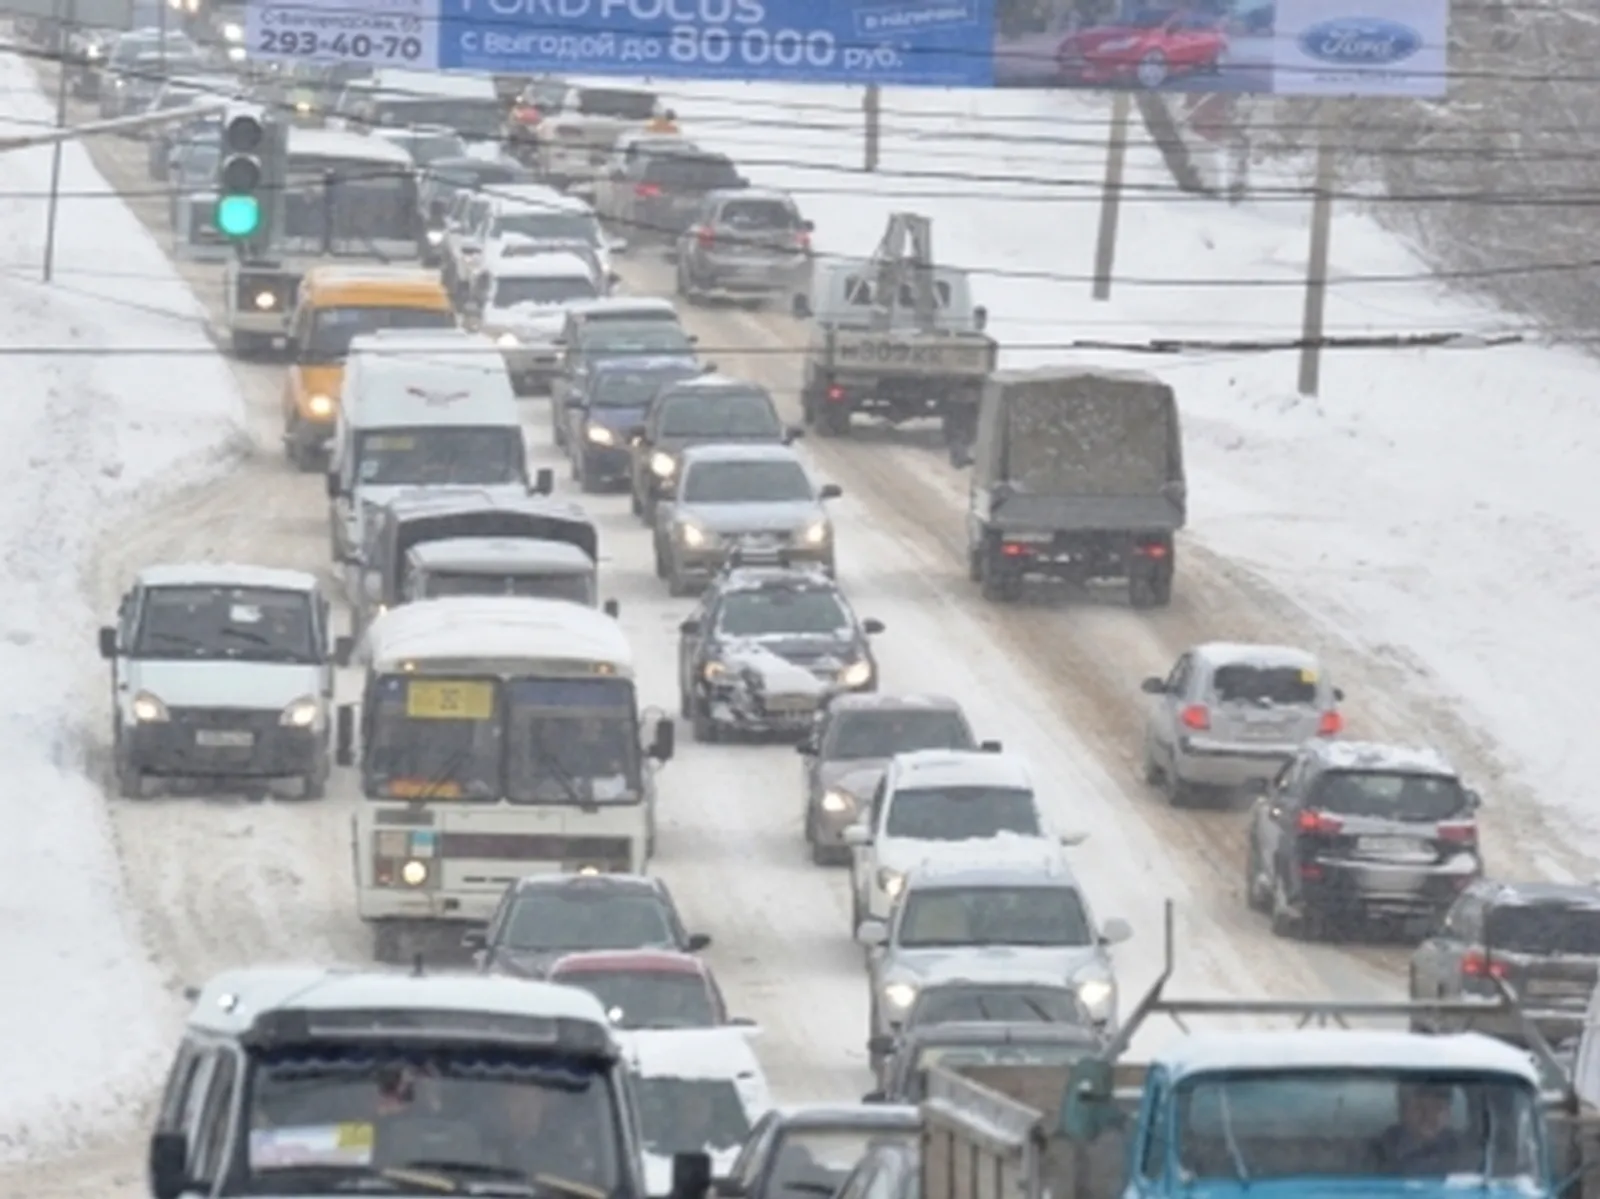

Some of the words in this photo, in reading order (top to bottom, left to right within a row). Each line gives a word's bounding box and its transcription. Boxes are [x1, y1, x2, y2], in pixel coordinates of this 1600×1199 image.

[258, 29, 422, 60] 293-40-70
[620, 37, 663, 61] до
[668, 26, 732, 64] 80
[739, 27, 836, 67] 000
[1320, 29, 1397, 58] Ford
